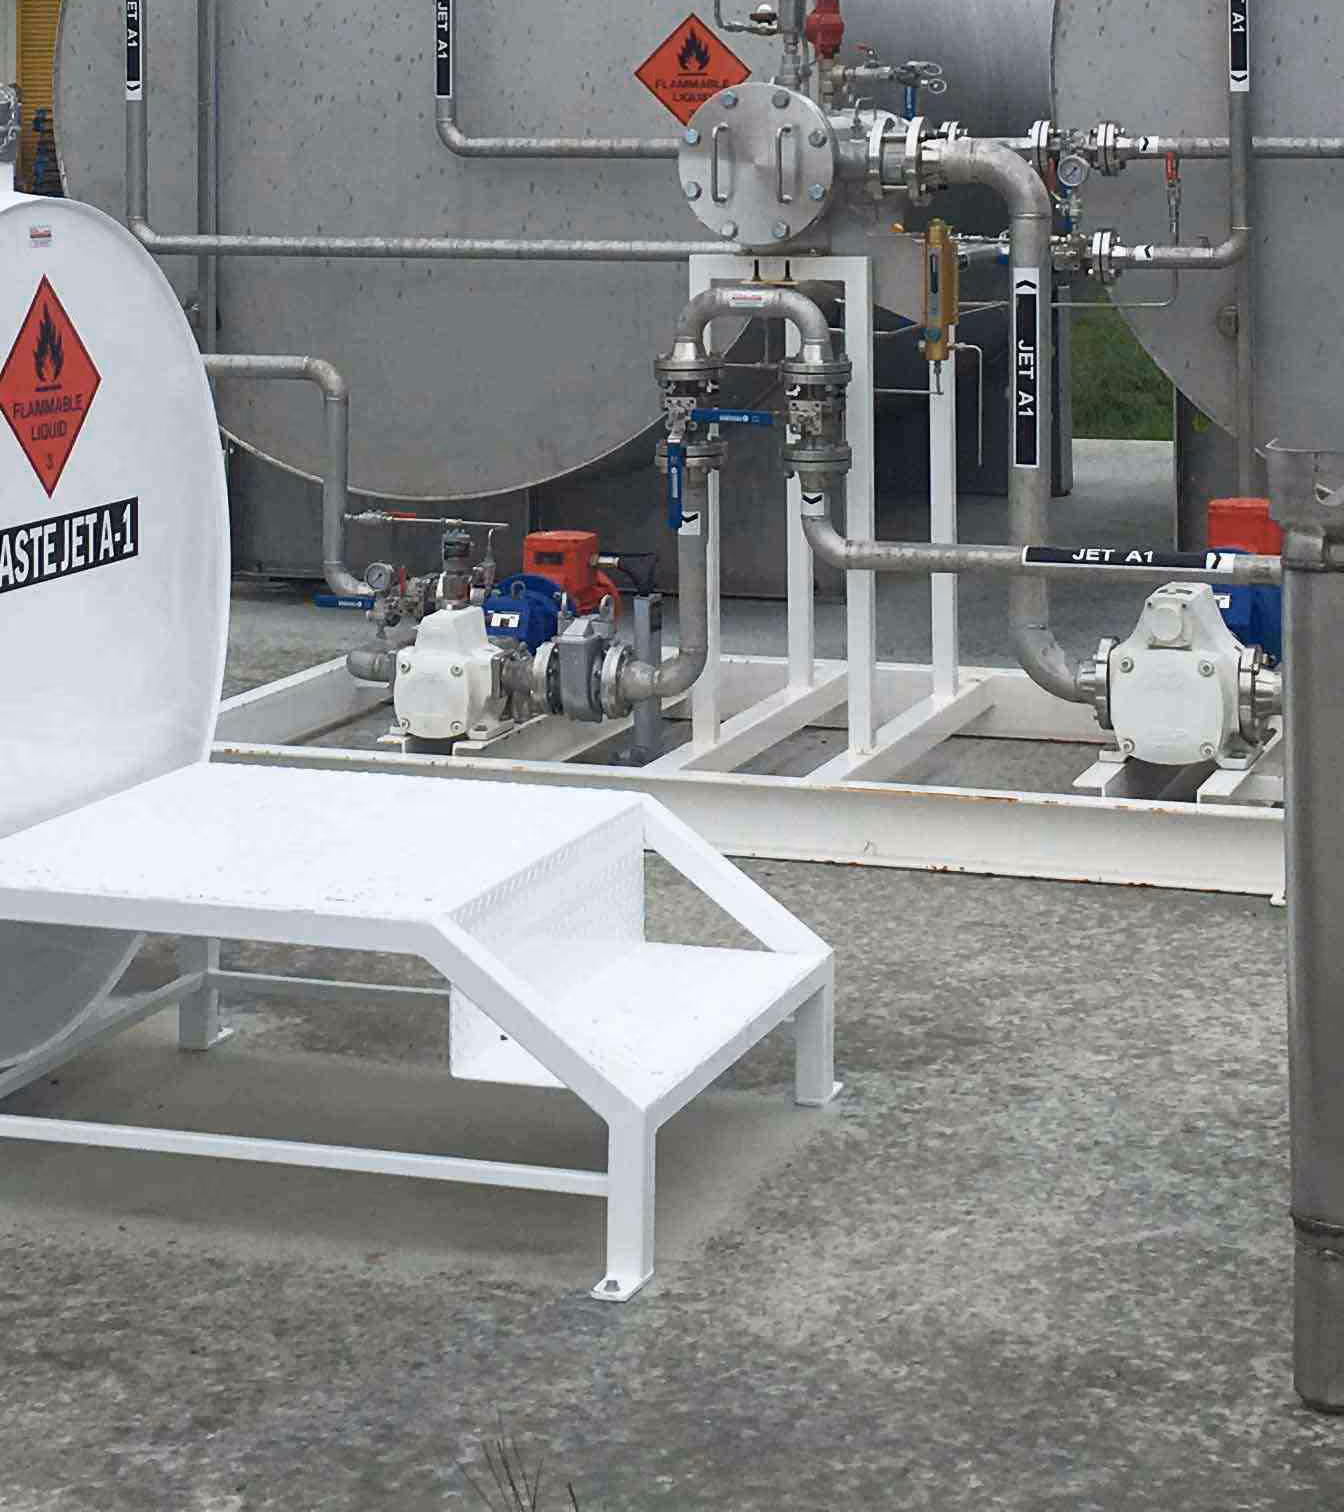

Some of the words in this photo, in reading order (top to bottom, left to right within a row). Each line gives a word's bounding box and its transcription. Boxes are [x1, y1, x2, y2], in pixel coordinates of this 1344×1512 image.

[437, 1, 448, 31] JET
[1232, 12, 1245, 32] A1
[127, 29, 138, 47] A1
[437, 40, 448, 58] A1
[655, 79, 729, 89] FLAMMABLE
[1018, 339, 1034, 380] JET
[12, 393, 83, 420] FLAMMABLE
[1018, 390, 1034, 416] A1
[30, 420, 68, 441] LIQUID
[45, 451, 54, 470] 3
[60, 510, 99, 572] JET
[100, 502, 134, 562] A-1
[1072, 548, 1115, 562] JET
[1125, 550, 1154, 563] A1
